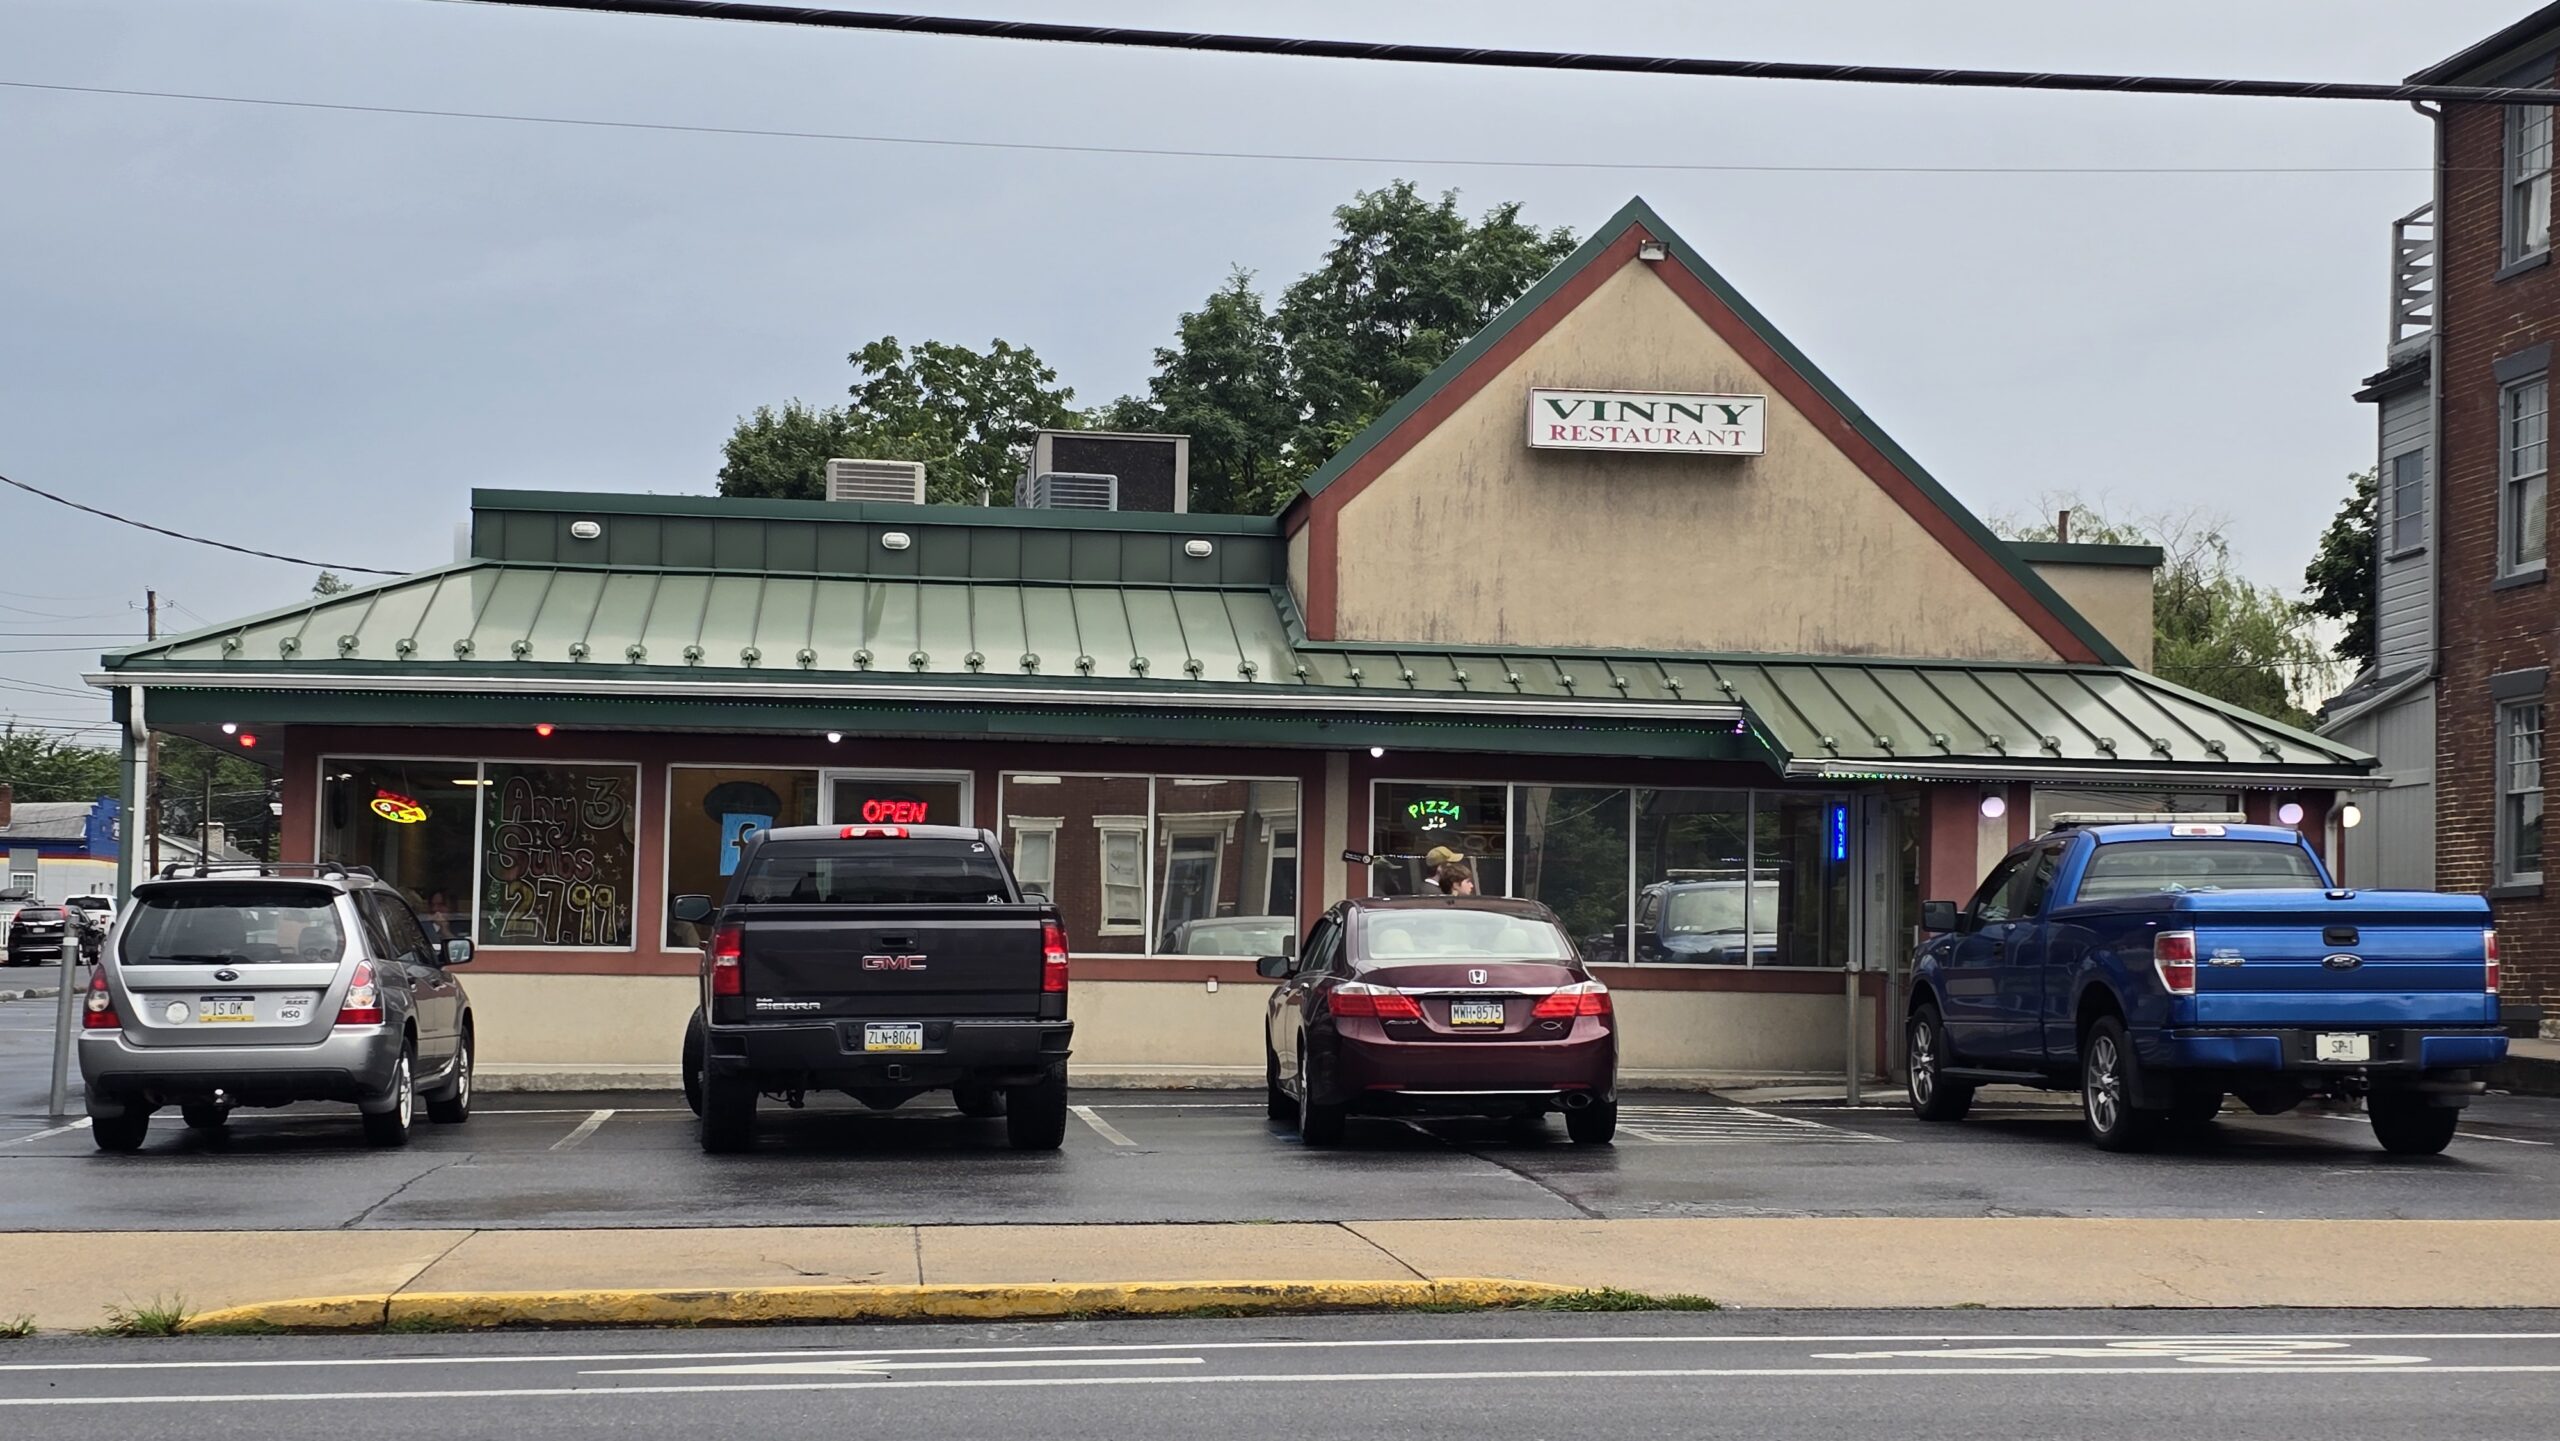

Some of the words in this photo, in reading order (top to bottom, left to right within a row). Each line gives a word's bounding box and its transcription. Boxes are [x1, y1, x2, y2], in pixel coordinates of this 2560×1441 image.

[1543, 398, 1753, 425] VINNY
[1549, 424, 1746, 446] RESTAURANT
[501, 776, 578, 849] Any
[582, 777, 625, 830] 3
[862, 799, 928, 823] OPEN
[1408, 800, 1460, 820] PIZZA
[487, 823, 595, 883] Subs
[501, 878, 618, 945] 27.99
[862, 955, 927, 970] GMC
[756, 1002, 821, 1010] SIERRA
